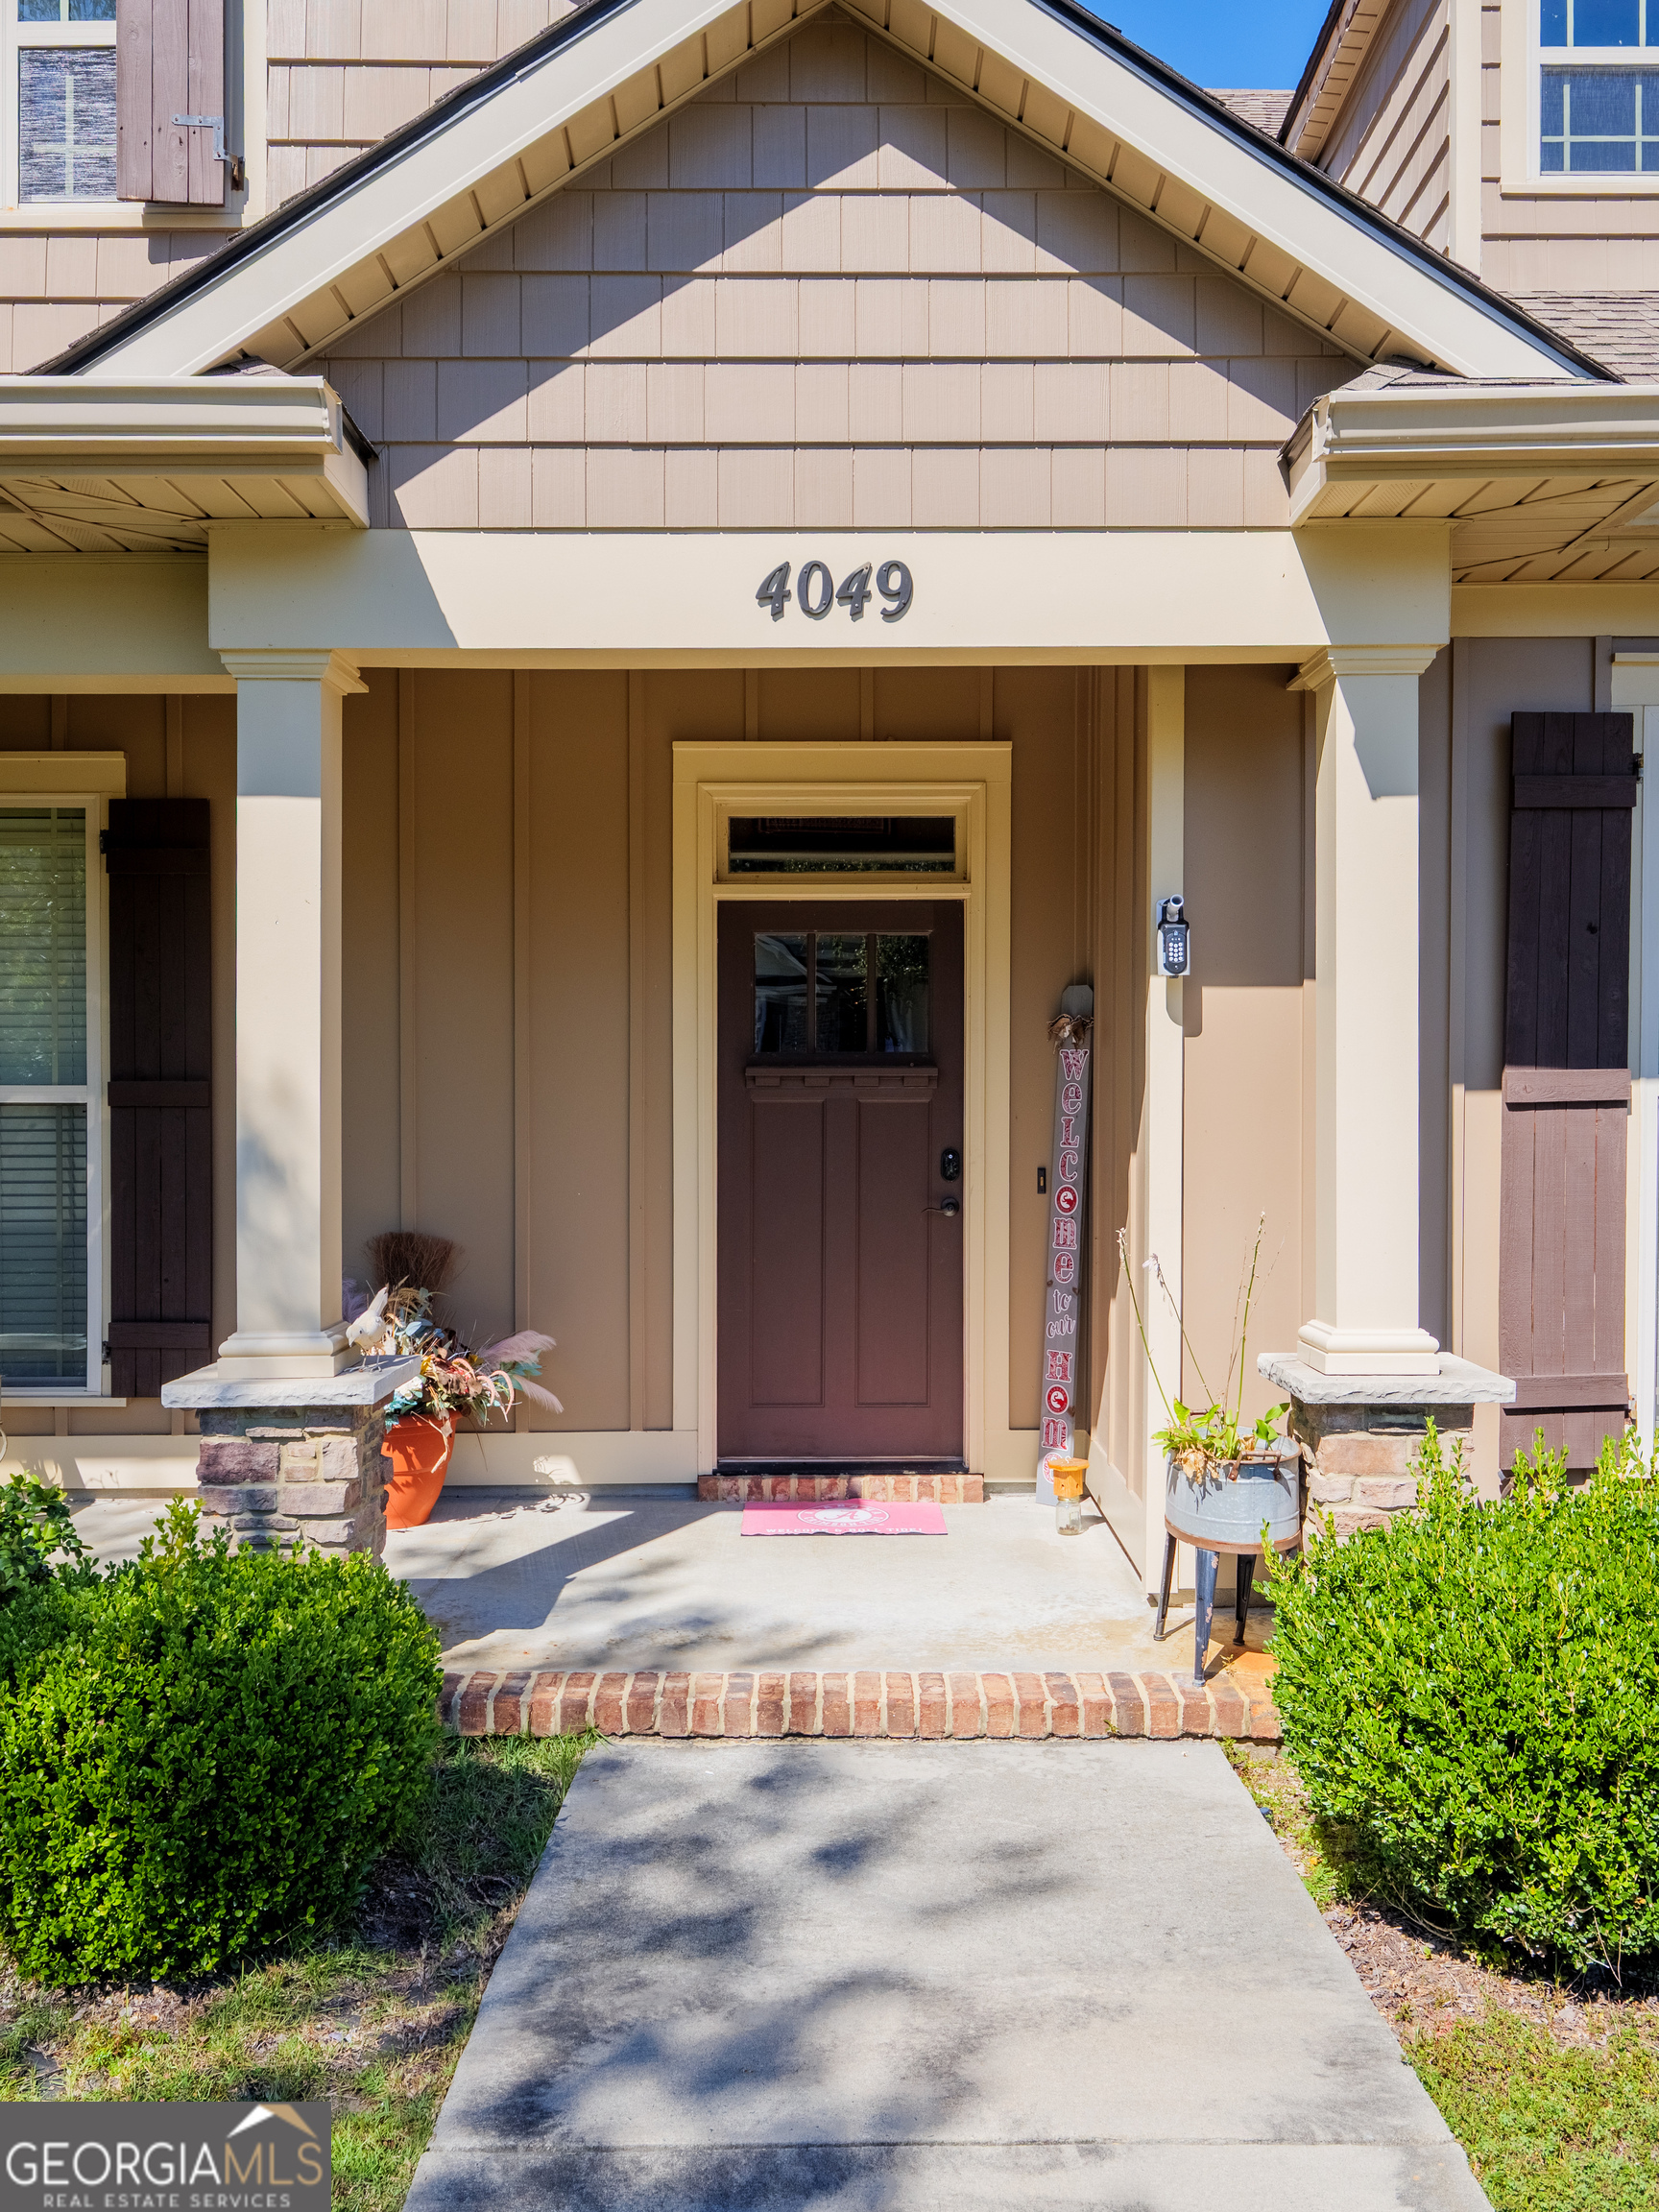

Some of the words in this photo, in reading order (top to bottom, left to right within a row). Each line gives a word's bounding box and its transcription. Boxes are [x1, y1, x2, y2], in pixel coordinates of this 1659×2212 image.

[755, 560, 914, 617] 4049
[1052, 1288, 1072, 1314] to
[1046, 1313, 1076, 1339] our
